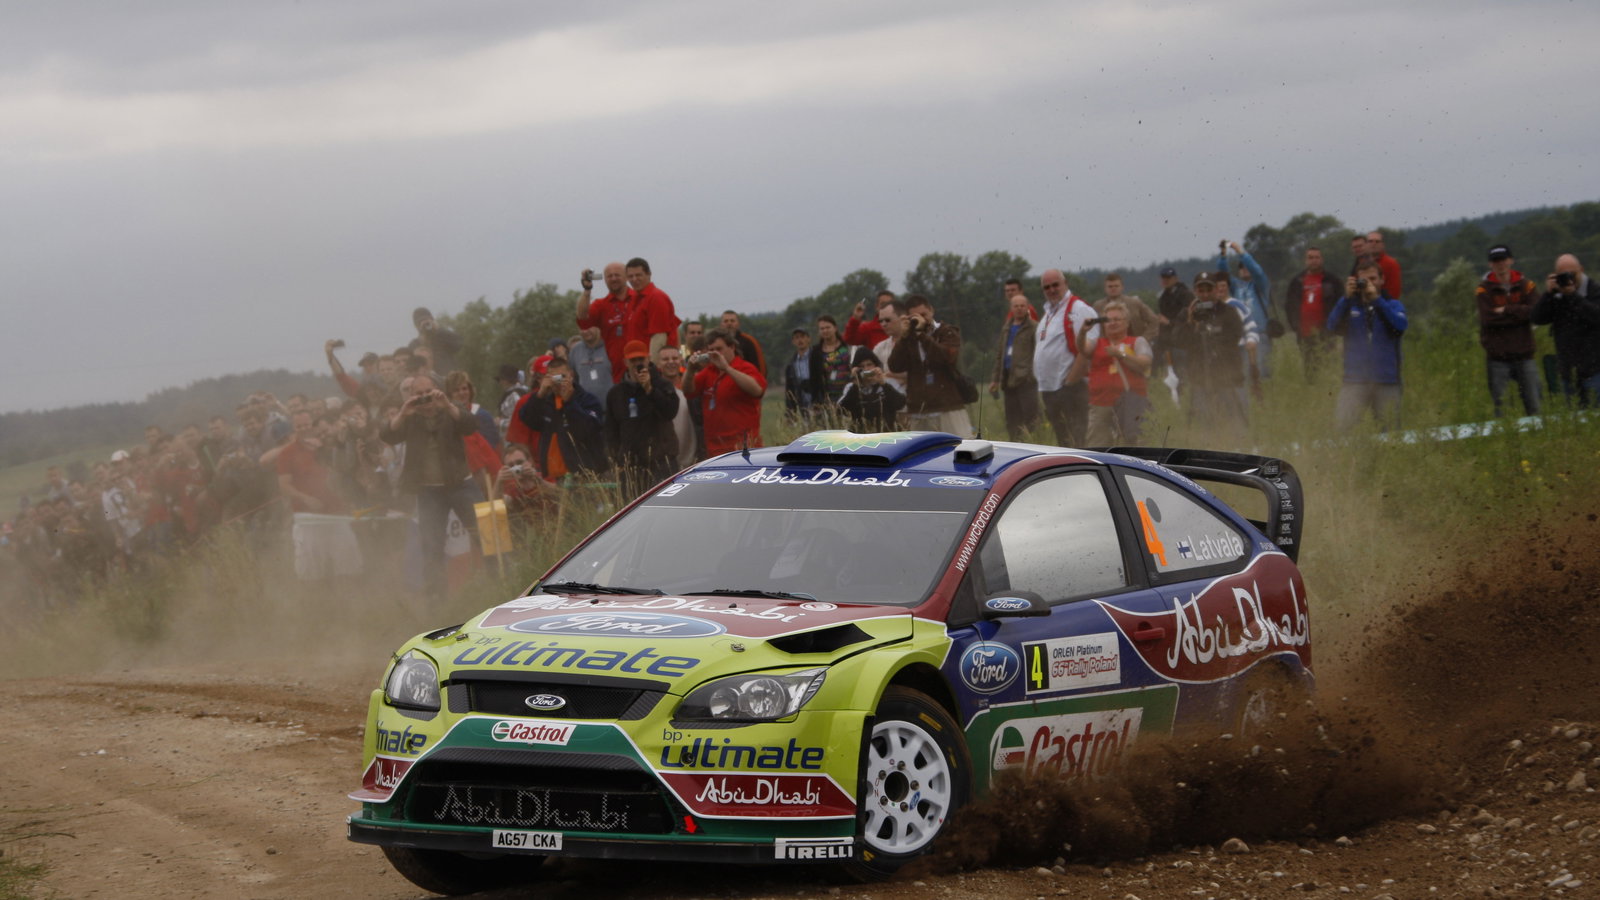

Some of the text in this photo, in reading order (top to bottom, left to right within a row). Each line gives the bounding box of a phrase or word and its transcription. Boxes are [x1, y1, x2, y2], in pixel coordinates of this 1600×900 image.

[955, 493, 1001, 572] www.wrcford.com
[1137, 501, 1168, 567] 4
[1188, 530, 1244, 561] Latvala
[994, 599, 1023, 609] Ford
[539, 612, 688, 634] Ford
[453, 641, 701, 677] ultimate
[1053, 644, 1102, 659] ORLEN Platinum
[971, 650, 1008, 685] Ford
[1031, 646, 1043, 688] 4
[1068, 658, 1089, 678] Rally
[1089, 654, 1118, 674] Poland
[532, 694, 558, 706] Ford
[509, 722, 569, 743] Castrol
[663, 728, 683, 743] bp
[660, 737, 825, 769] ultimate
[1028, 718, 1131, 779] Castrol
[497, 832, 556, 848] AG57 CKA
[774, 837, 856, 859] PIRELLI
